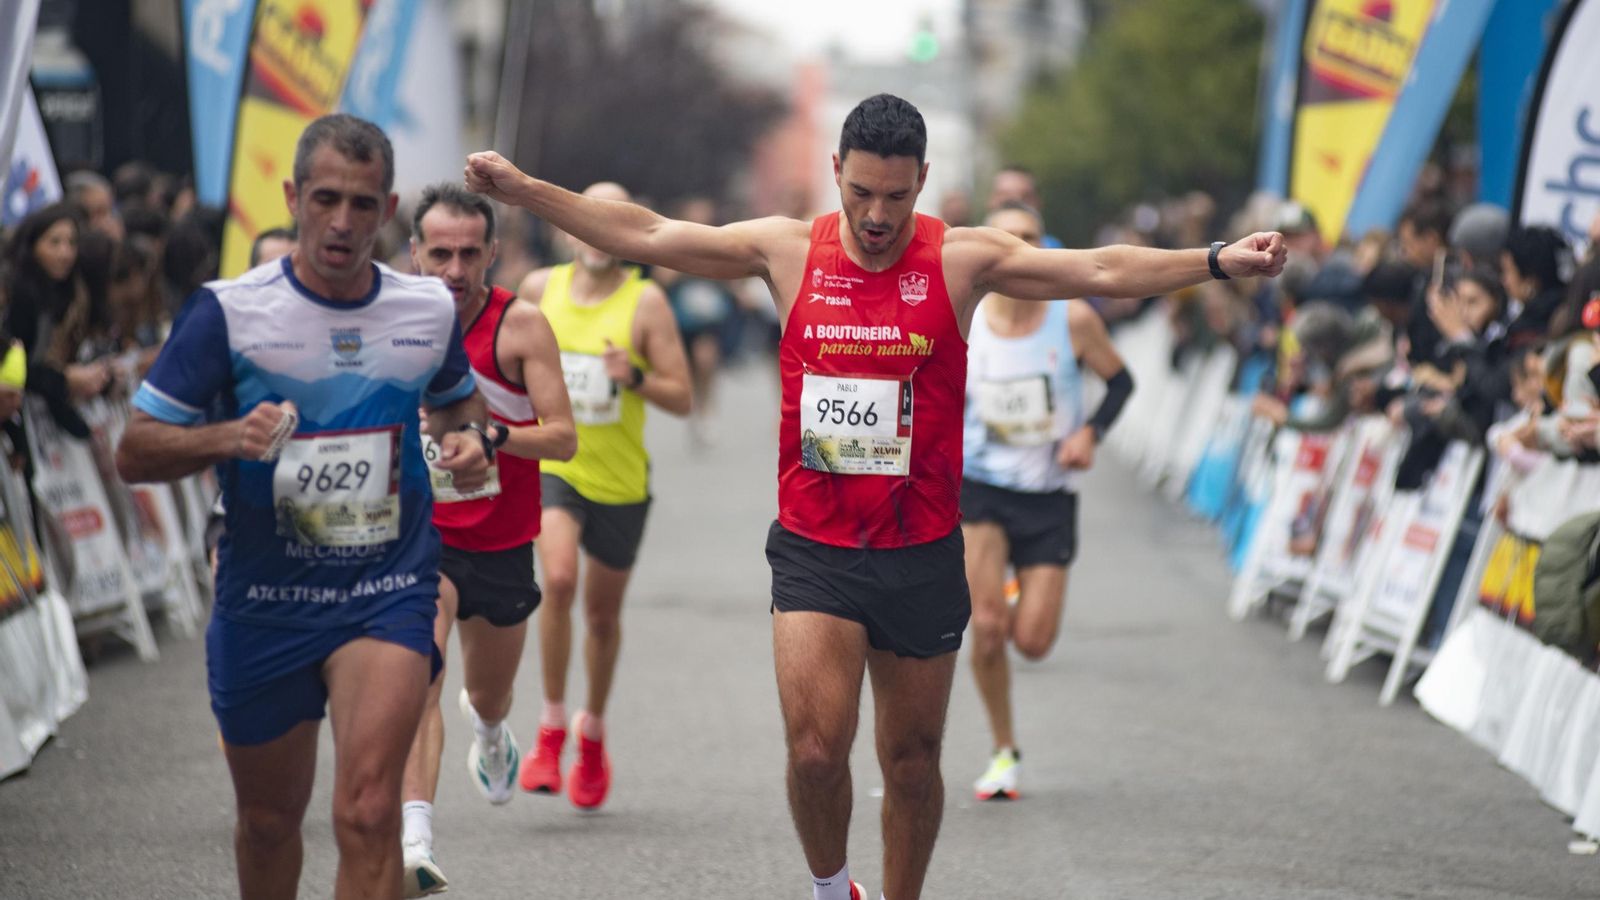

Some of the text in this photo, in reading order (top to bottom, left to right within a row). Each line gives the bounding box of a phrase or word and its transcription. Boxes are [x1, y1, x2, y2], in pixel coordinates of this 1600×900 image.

[803, 325, 902, 340] A BOUTUREIRA
[877, 338, 934, 356] natural
[837, 383, 858, 393] PABLO
[816, 398, 878, 426] 9566
[297, 460, 371, 493] 9629
